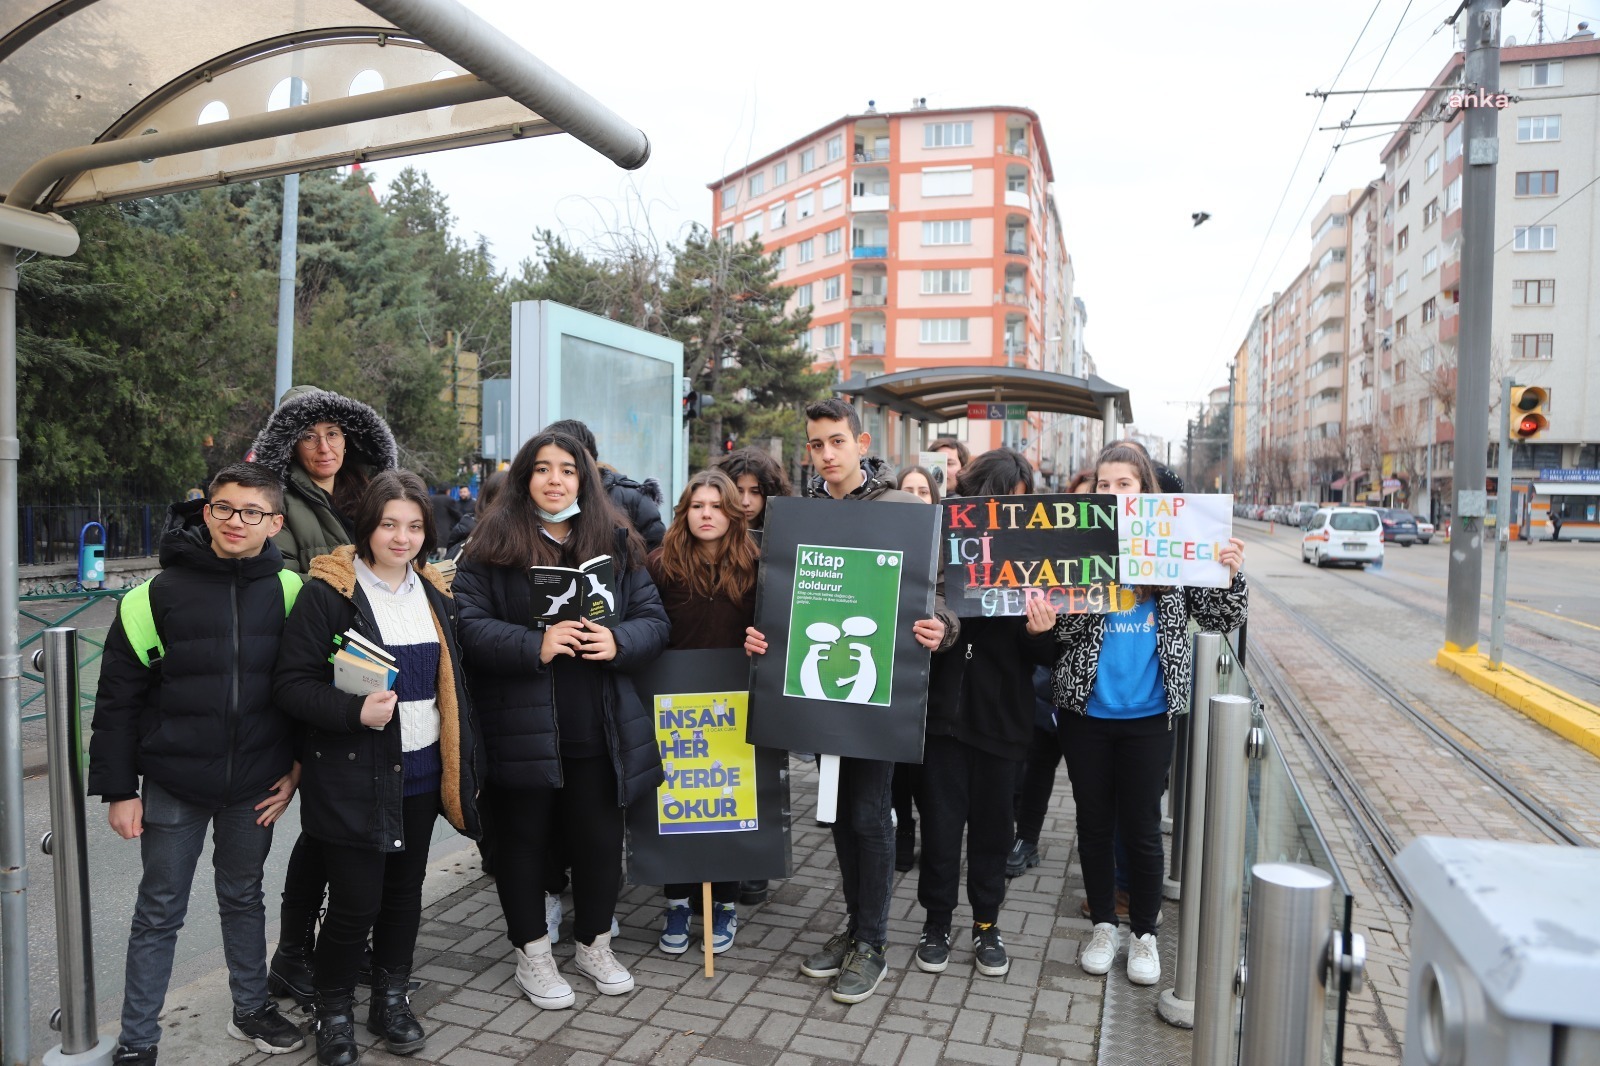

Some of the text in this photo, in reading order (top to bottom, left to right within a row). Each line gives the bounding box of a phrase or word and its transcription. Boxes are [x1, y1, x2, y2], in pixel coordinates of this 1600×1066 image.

[949, 498, 1117, 530] KİTABIN
[1131, 520, 1171, 537] OKU
[948, 532, 993, 565] İÇİ
[801, 550, 845, 571] Kitap
[1129, 559, 1179, 578] DOKU
[799, 568, 843, 579] boşlukları
[966, 555, 1119, 587] HAYATIN
[798, 580, 842, 592] doldurur
[1104, 622, 1151, 633] ALWAYS
[660, 739, 709, 759] HER
[664, 767, 741, 789] YERDE
[663, 798, 737, 820] OKUR
